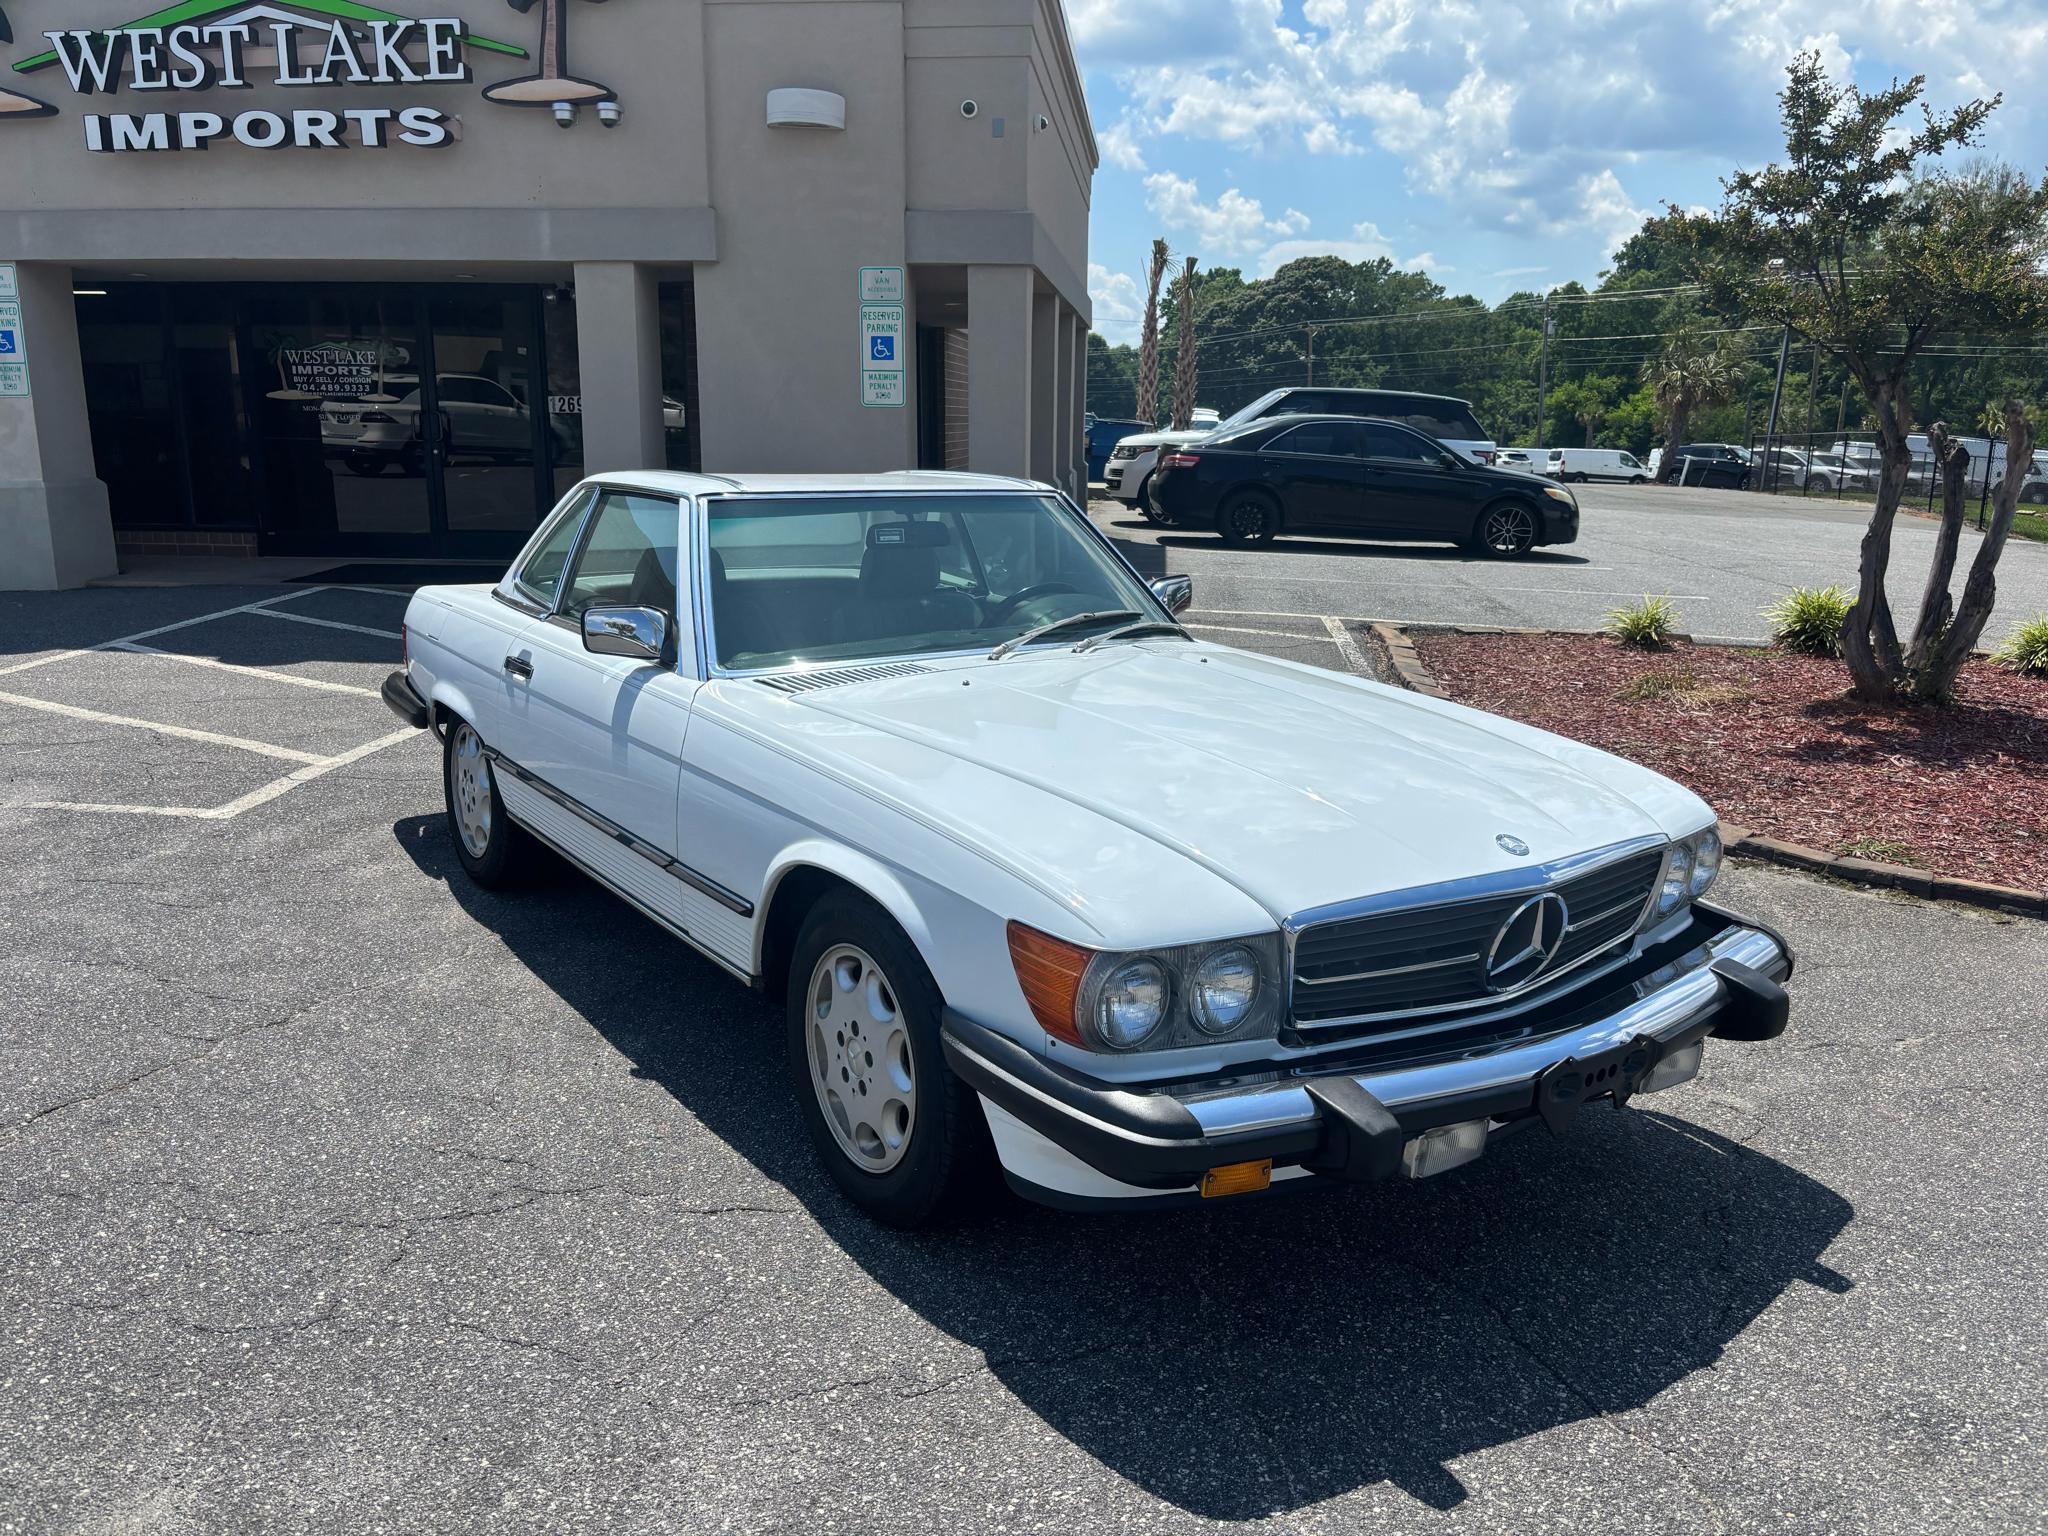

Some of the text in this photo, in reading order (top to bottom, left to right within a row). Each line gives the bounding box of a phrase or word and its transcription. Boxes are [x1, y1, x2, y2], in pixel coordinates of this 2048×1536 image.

[43, 18, 467, 93] WEST LAKE
[82, 106, 452, 151] IMPORTS
[874, 277, 890, 285] VAN
[863, 311, 901, 321] RESERVED
[866, 323, 899, 333] PARKING
[285, 349, 377, 365] WEST LAKE
[291, 365, 372, 376] IMPORTS
[293, 376, 307, 384] BUY
[315, 376, 332, 384] SELL
[339, 376, 372, 384] CONSIGN
[868, 373, 898, 381] MAXIMUM
[869, 382, 897, 390] PENALTY
